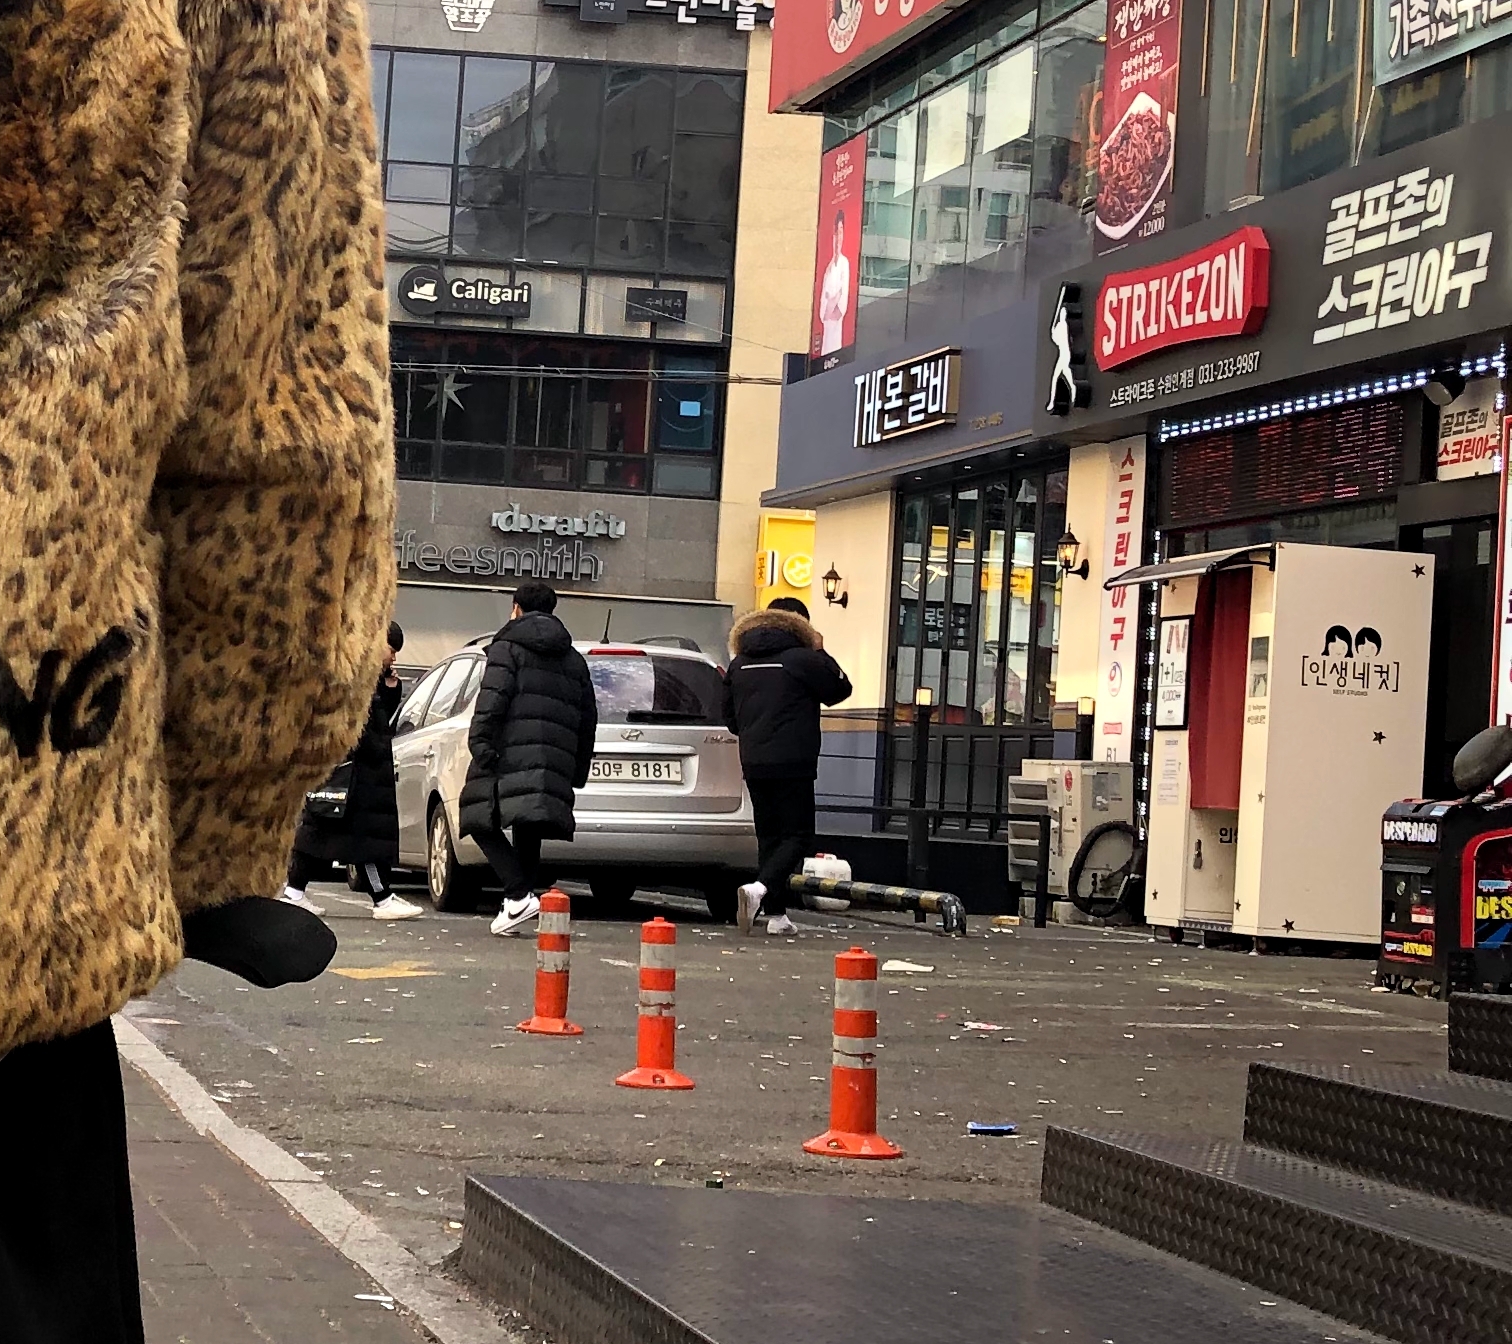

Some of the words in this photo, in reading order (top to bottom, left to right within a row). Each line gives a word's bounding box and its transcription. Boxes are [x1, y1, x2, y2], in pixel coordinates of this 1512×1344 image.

[1323, 167, 1454, 266] 골프존의
[451, 281, 528, 304] Caligari
[1101, 242, 1246, 357] STRIKEZON
[1313, 232, 1493, 345] 스크린야구
[1110, 380, 1154, 408] 스트라이크존
[1157, 373, 1194, 400] 수원인계점
[1198, 351, 1260, 384] 031-233-9987
[497, 502, 622, 539] draft
[394, 529, 600, 582] feesmith
[631, 762, 672, 778] 8181
[1219, 827, 1238, 844] 인
[1383, 820, 1437, 843] DESPERADO
